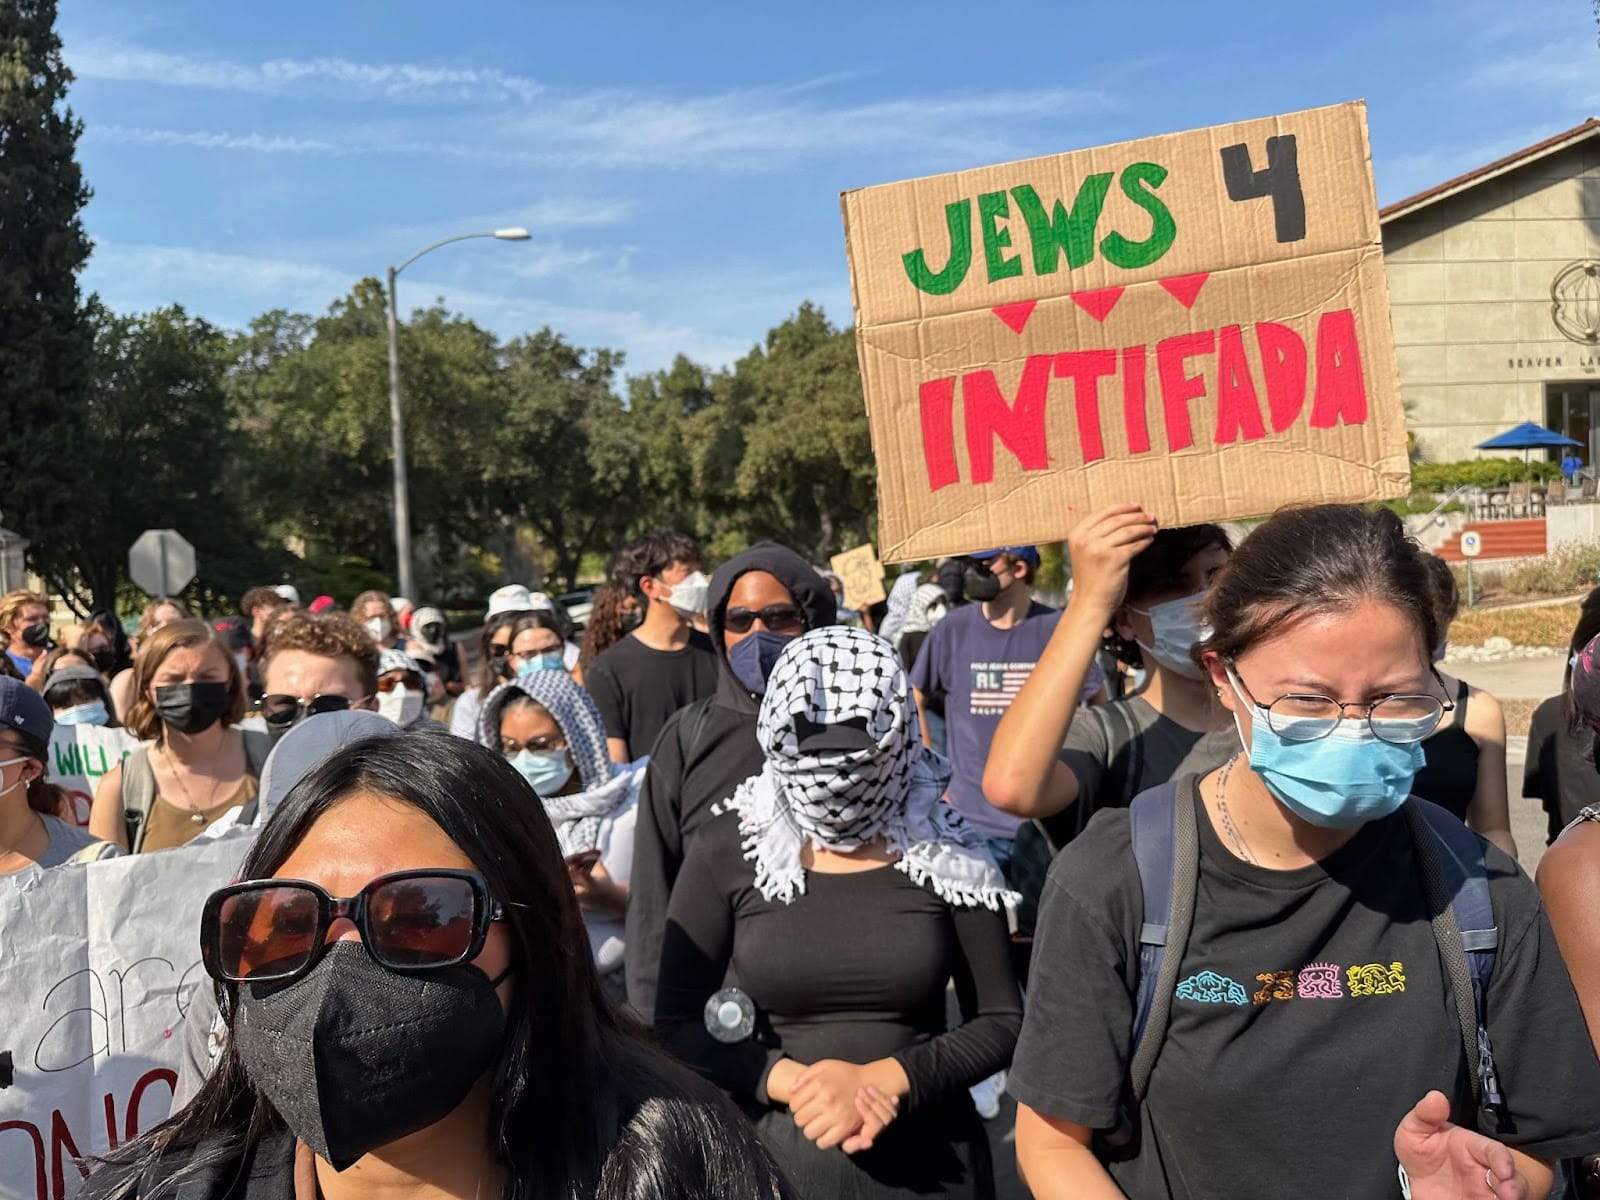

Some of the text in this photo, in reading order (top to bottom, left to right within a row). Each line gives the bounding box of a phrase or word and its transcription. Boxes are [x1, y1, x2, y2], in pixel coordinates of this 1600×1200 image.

[901, 133, 1306, 296] JEWS 4
[918, 307, 1368, 494] INTIFADA
